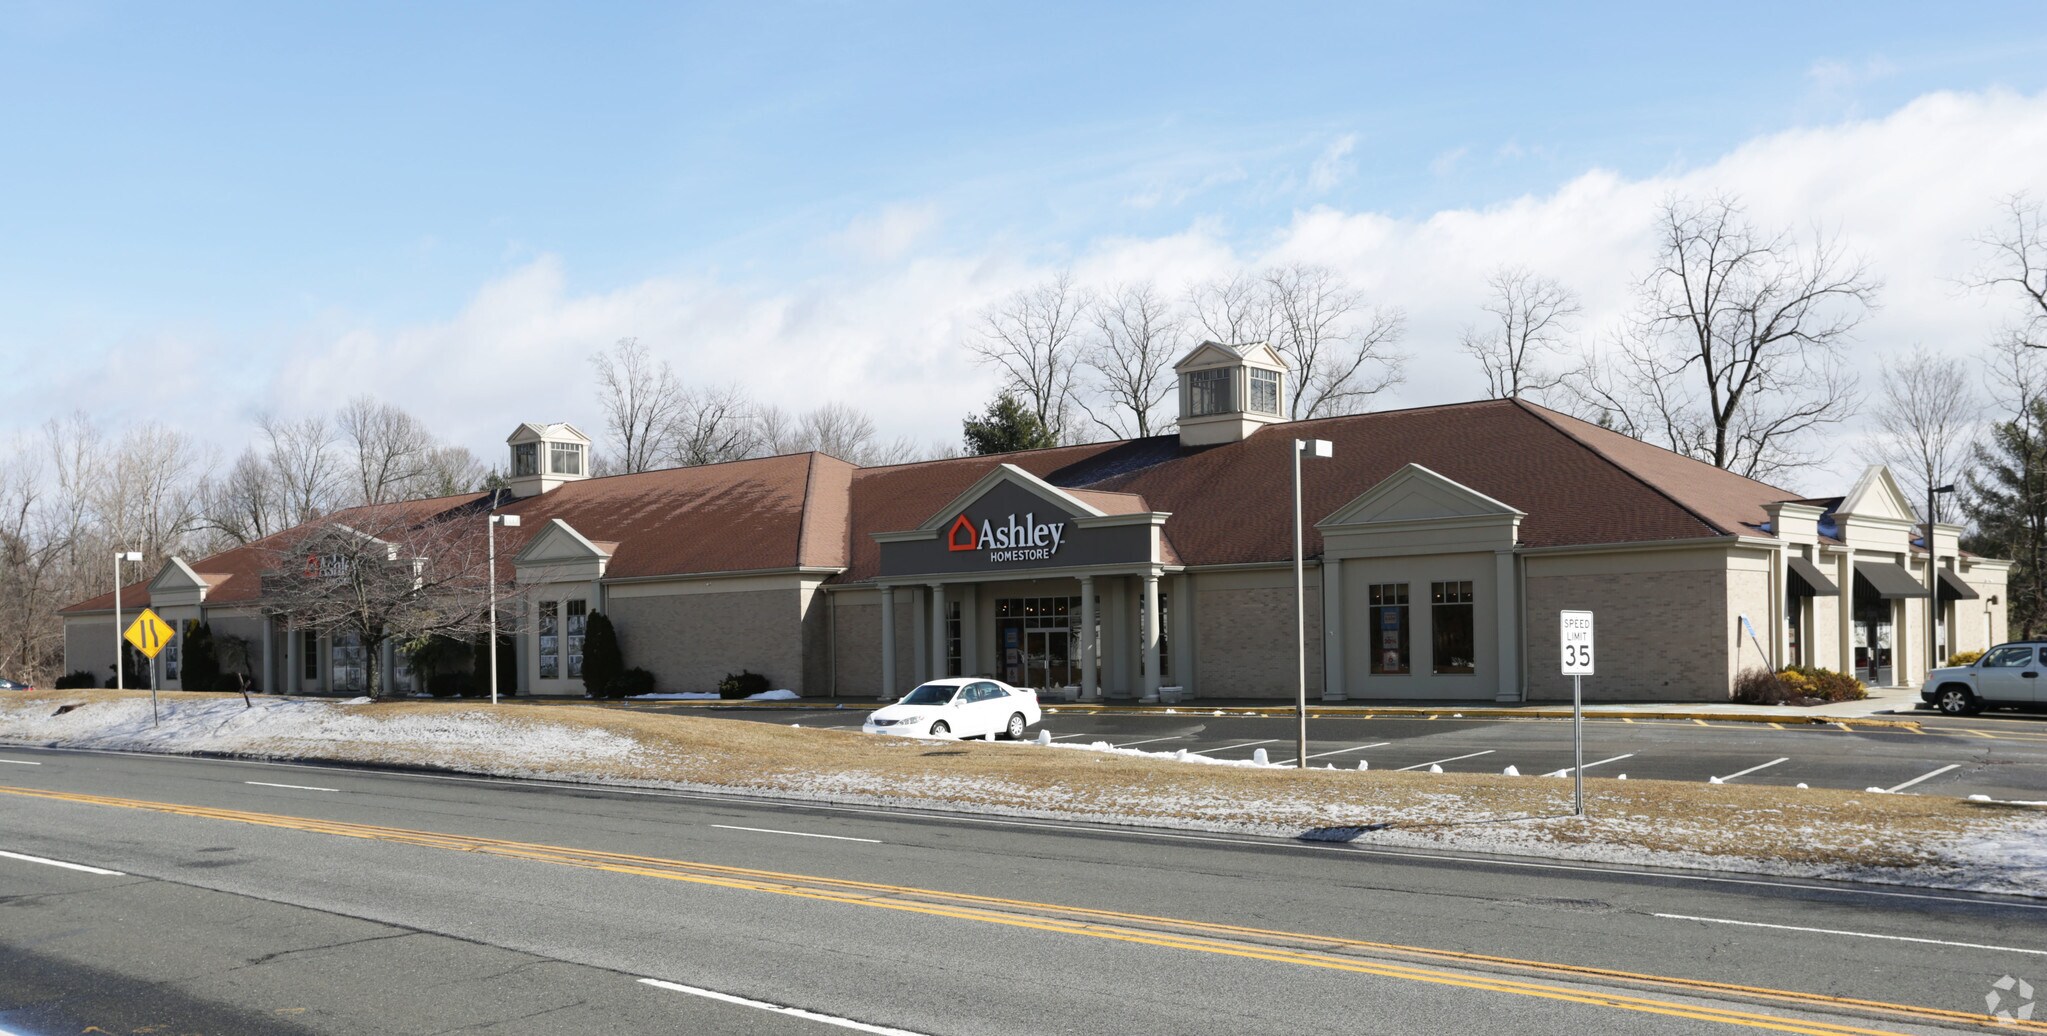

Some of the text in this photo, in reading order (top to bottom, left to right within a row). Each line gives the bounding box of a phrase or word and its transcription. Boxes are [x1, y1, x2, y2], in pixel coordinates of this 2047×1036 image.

[977, 512, 1064, 554] Ashley
[990, 548, 1049, 562] HOMESTORE
[1564, 618, 1590, 629] SPEED
[1566, 631, 1587, 641] LIMIT
[1565, 644, 1590, 667] 35
